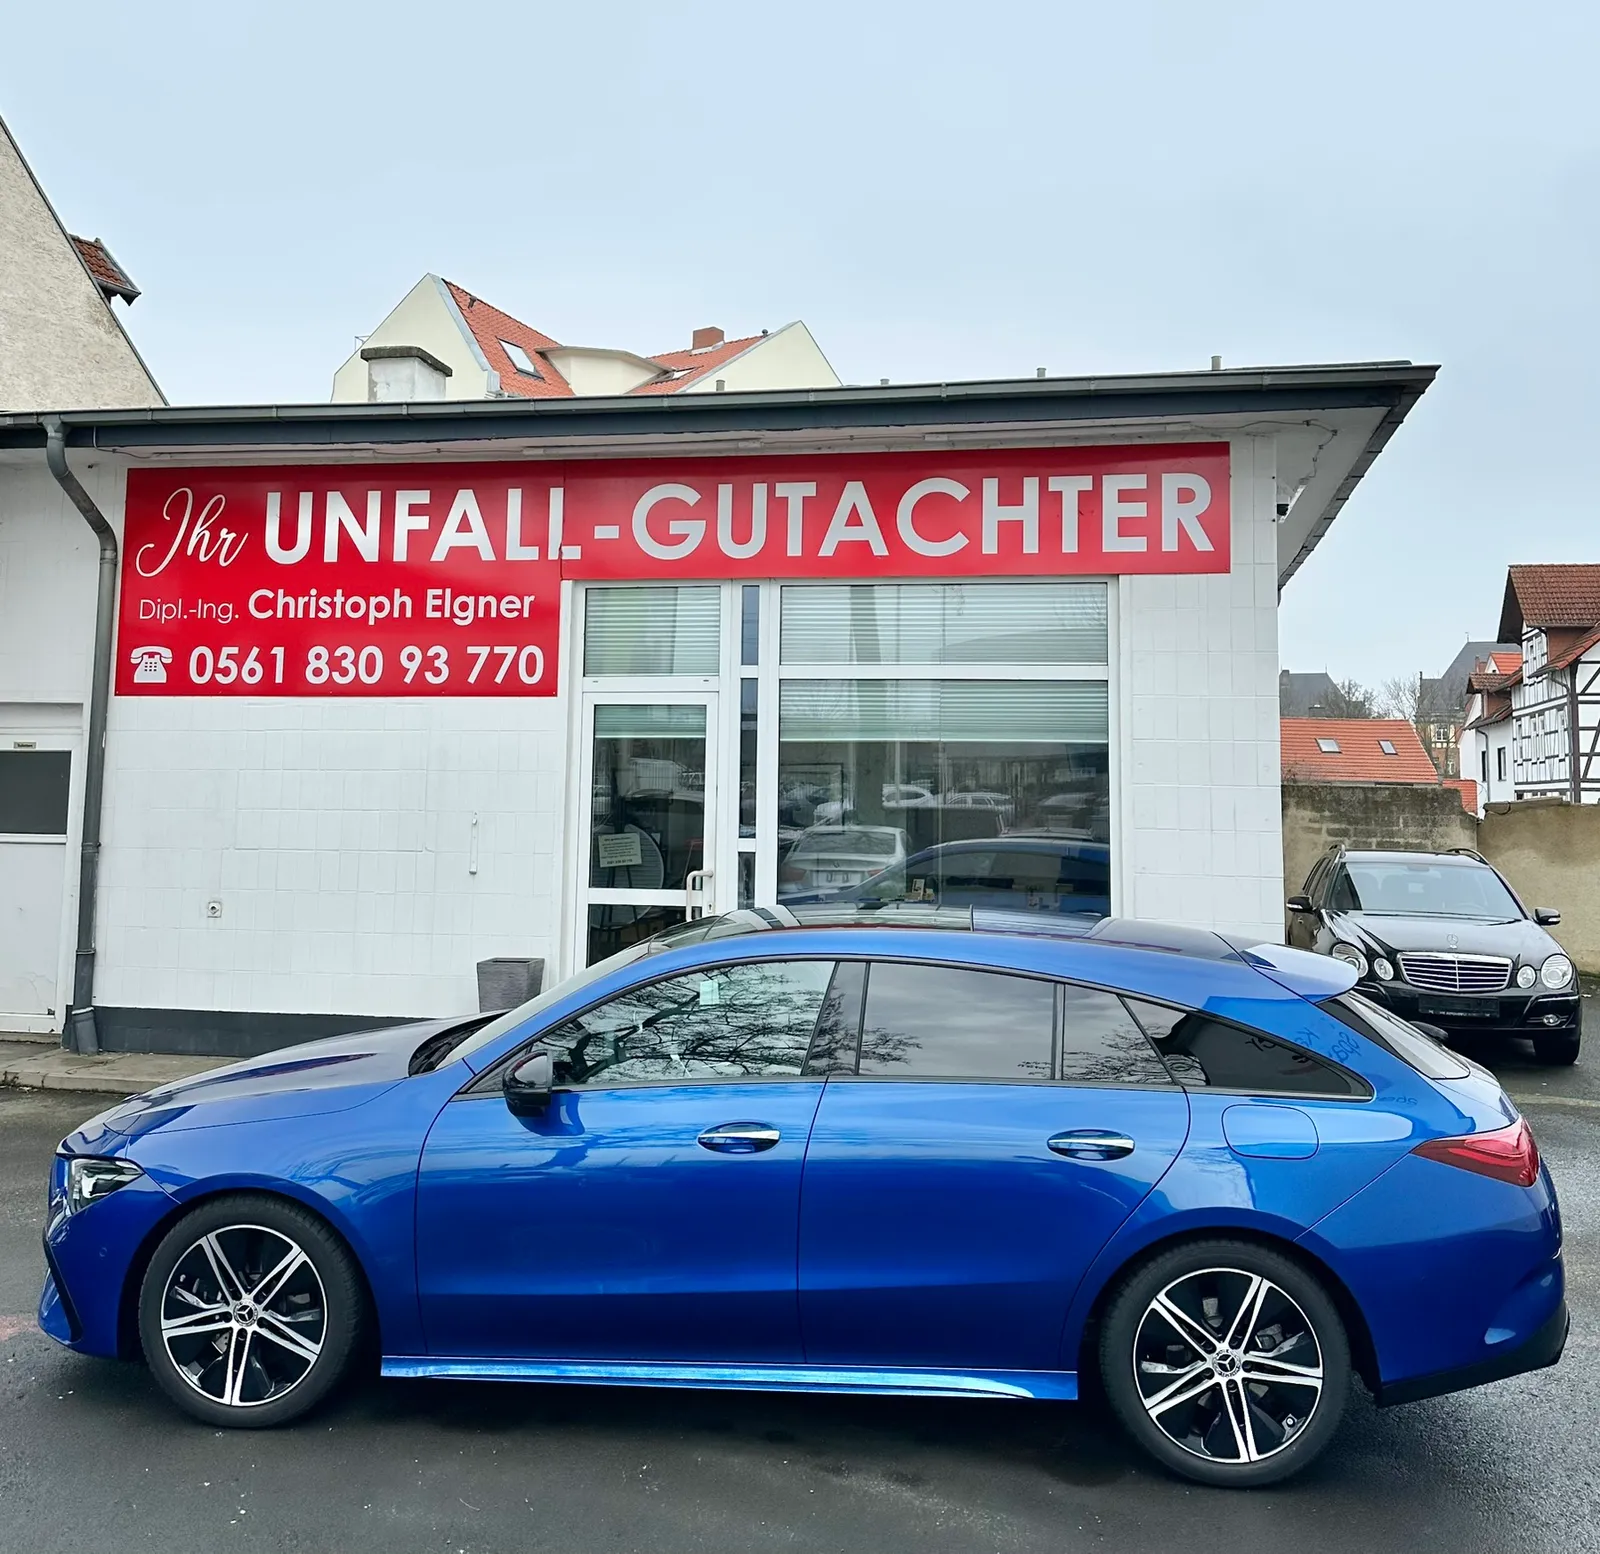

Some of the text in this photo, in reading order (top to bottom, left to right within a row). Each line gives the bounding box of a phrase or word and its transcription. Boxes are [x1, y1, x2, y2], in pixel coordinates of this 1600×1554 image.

[136, 488, 248, 577] Ihr
[140, 588, 535, 625] Dipl.-Ing. Christoph Elgner
[190, 645, 544, 684] 0561 830 93 770
